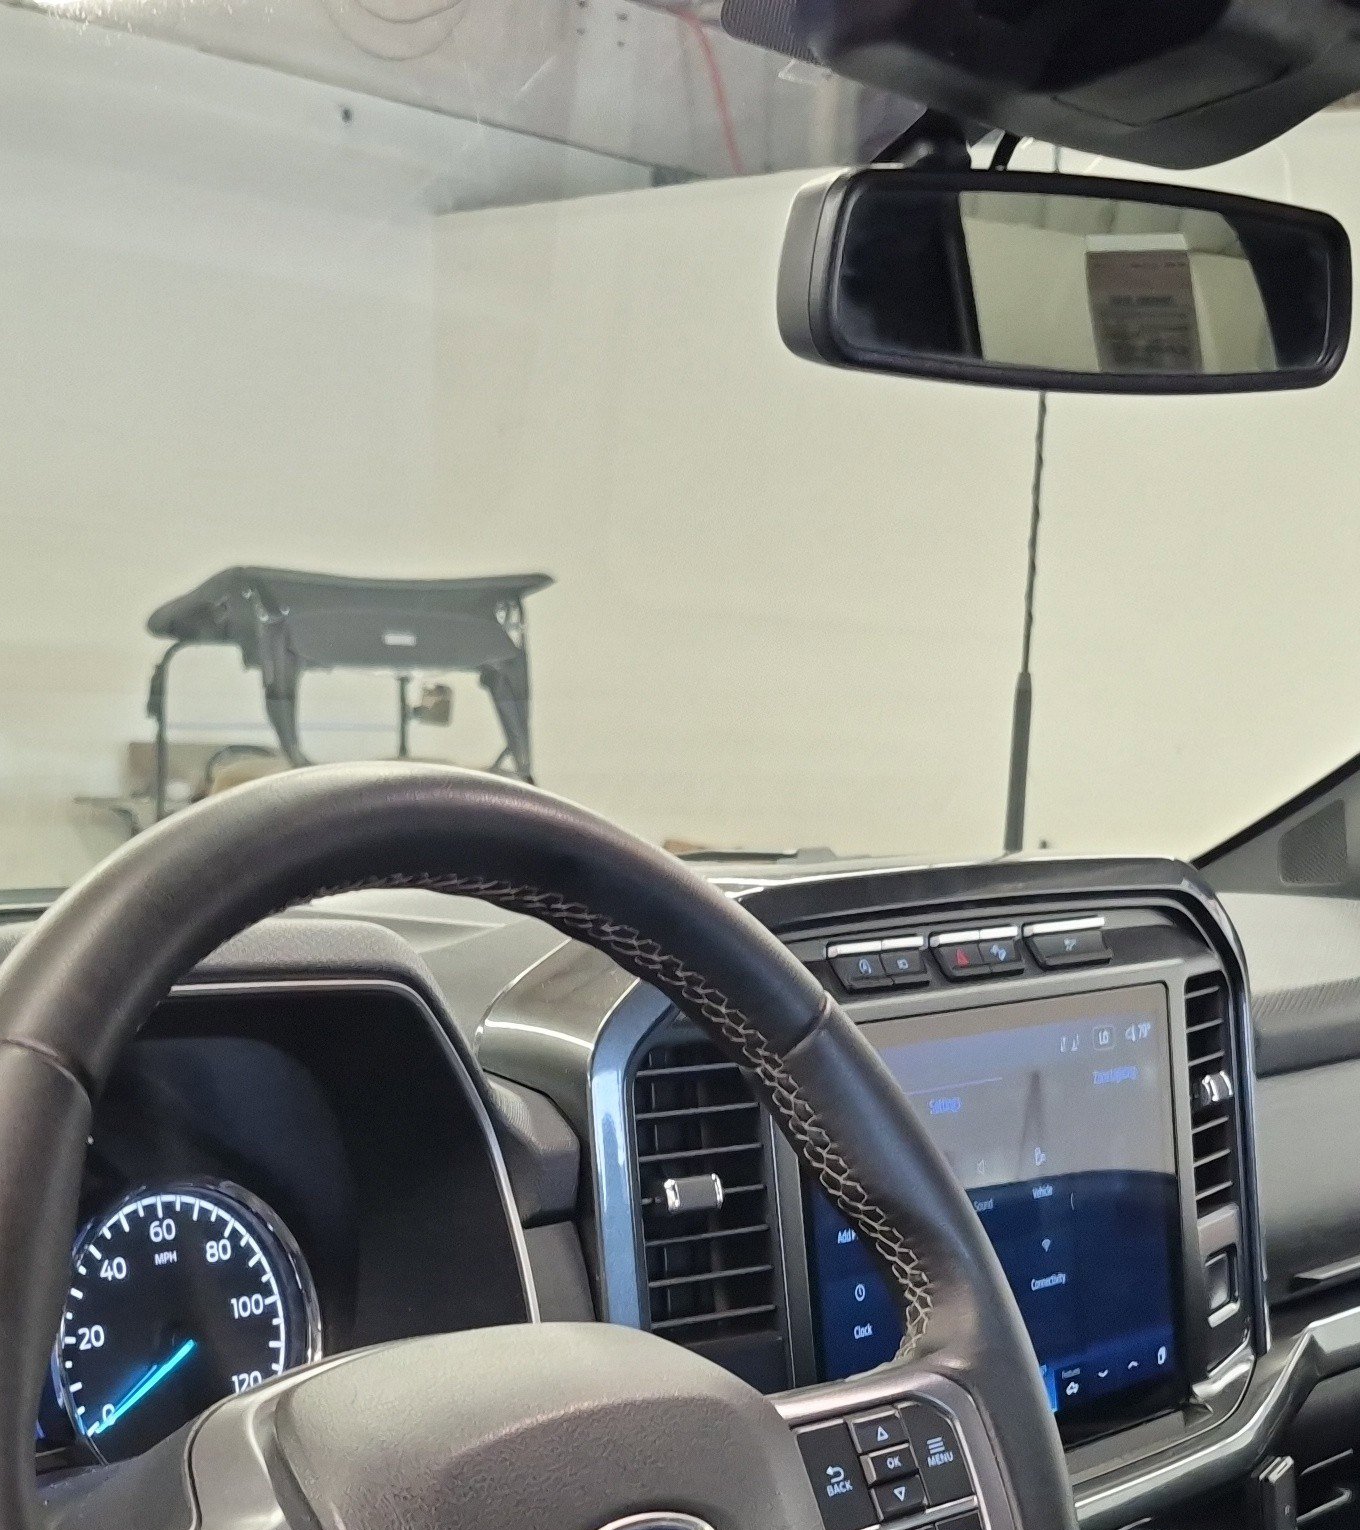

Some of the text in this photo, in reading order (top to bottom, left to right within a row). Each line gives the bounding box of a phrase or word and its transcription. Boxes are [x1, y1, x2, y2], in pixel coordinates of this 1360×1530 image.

[149, 1218, 177, 1243] 60
[154, 1250, 178, 1266] MPH
[205, 1238, 232, 1263] 80
[99, 1256, 127, 1281] 40
[1030, 1271, 1066, 1291] Connectivity
[230, 1293, 264, 1319] 100
[77, 1324, 105, 1350] 20
[853, 1322, 873, 1340] Clock
[886, 1456, 901, 1469] OK
[927, 1450, 953, 1468] MENU
[826, 1479, 853, 1497] BACK
